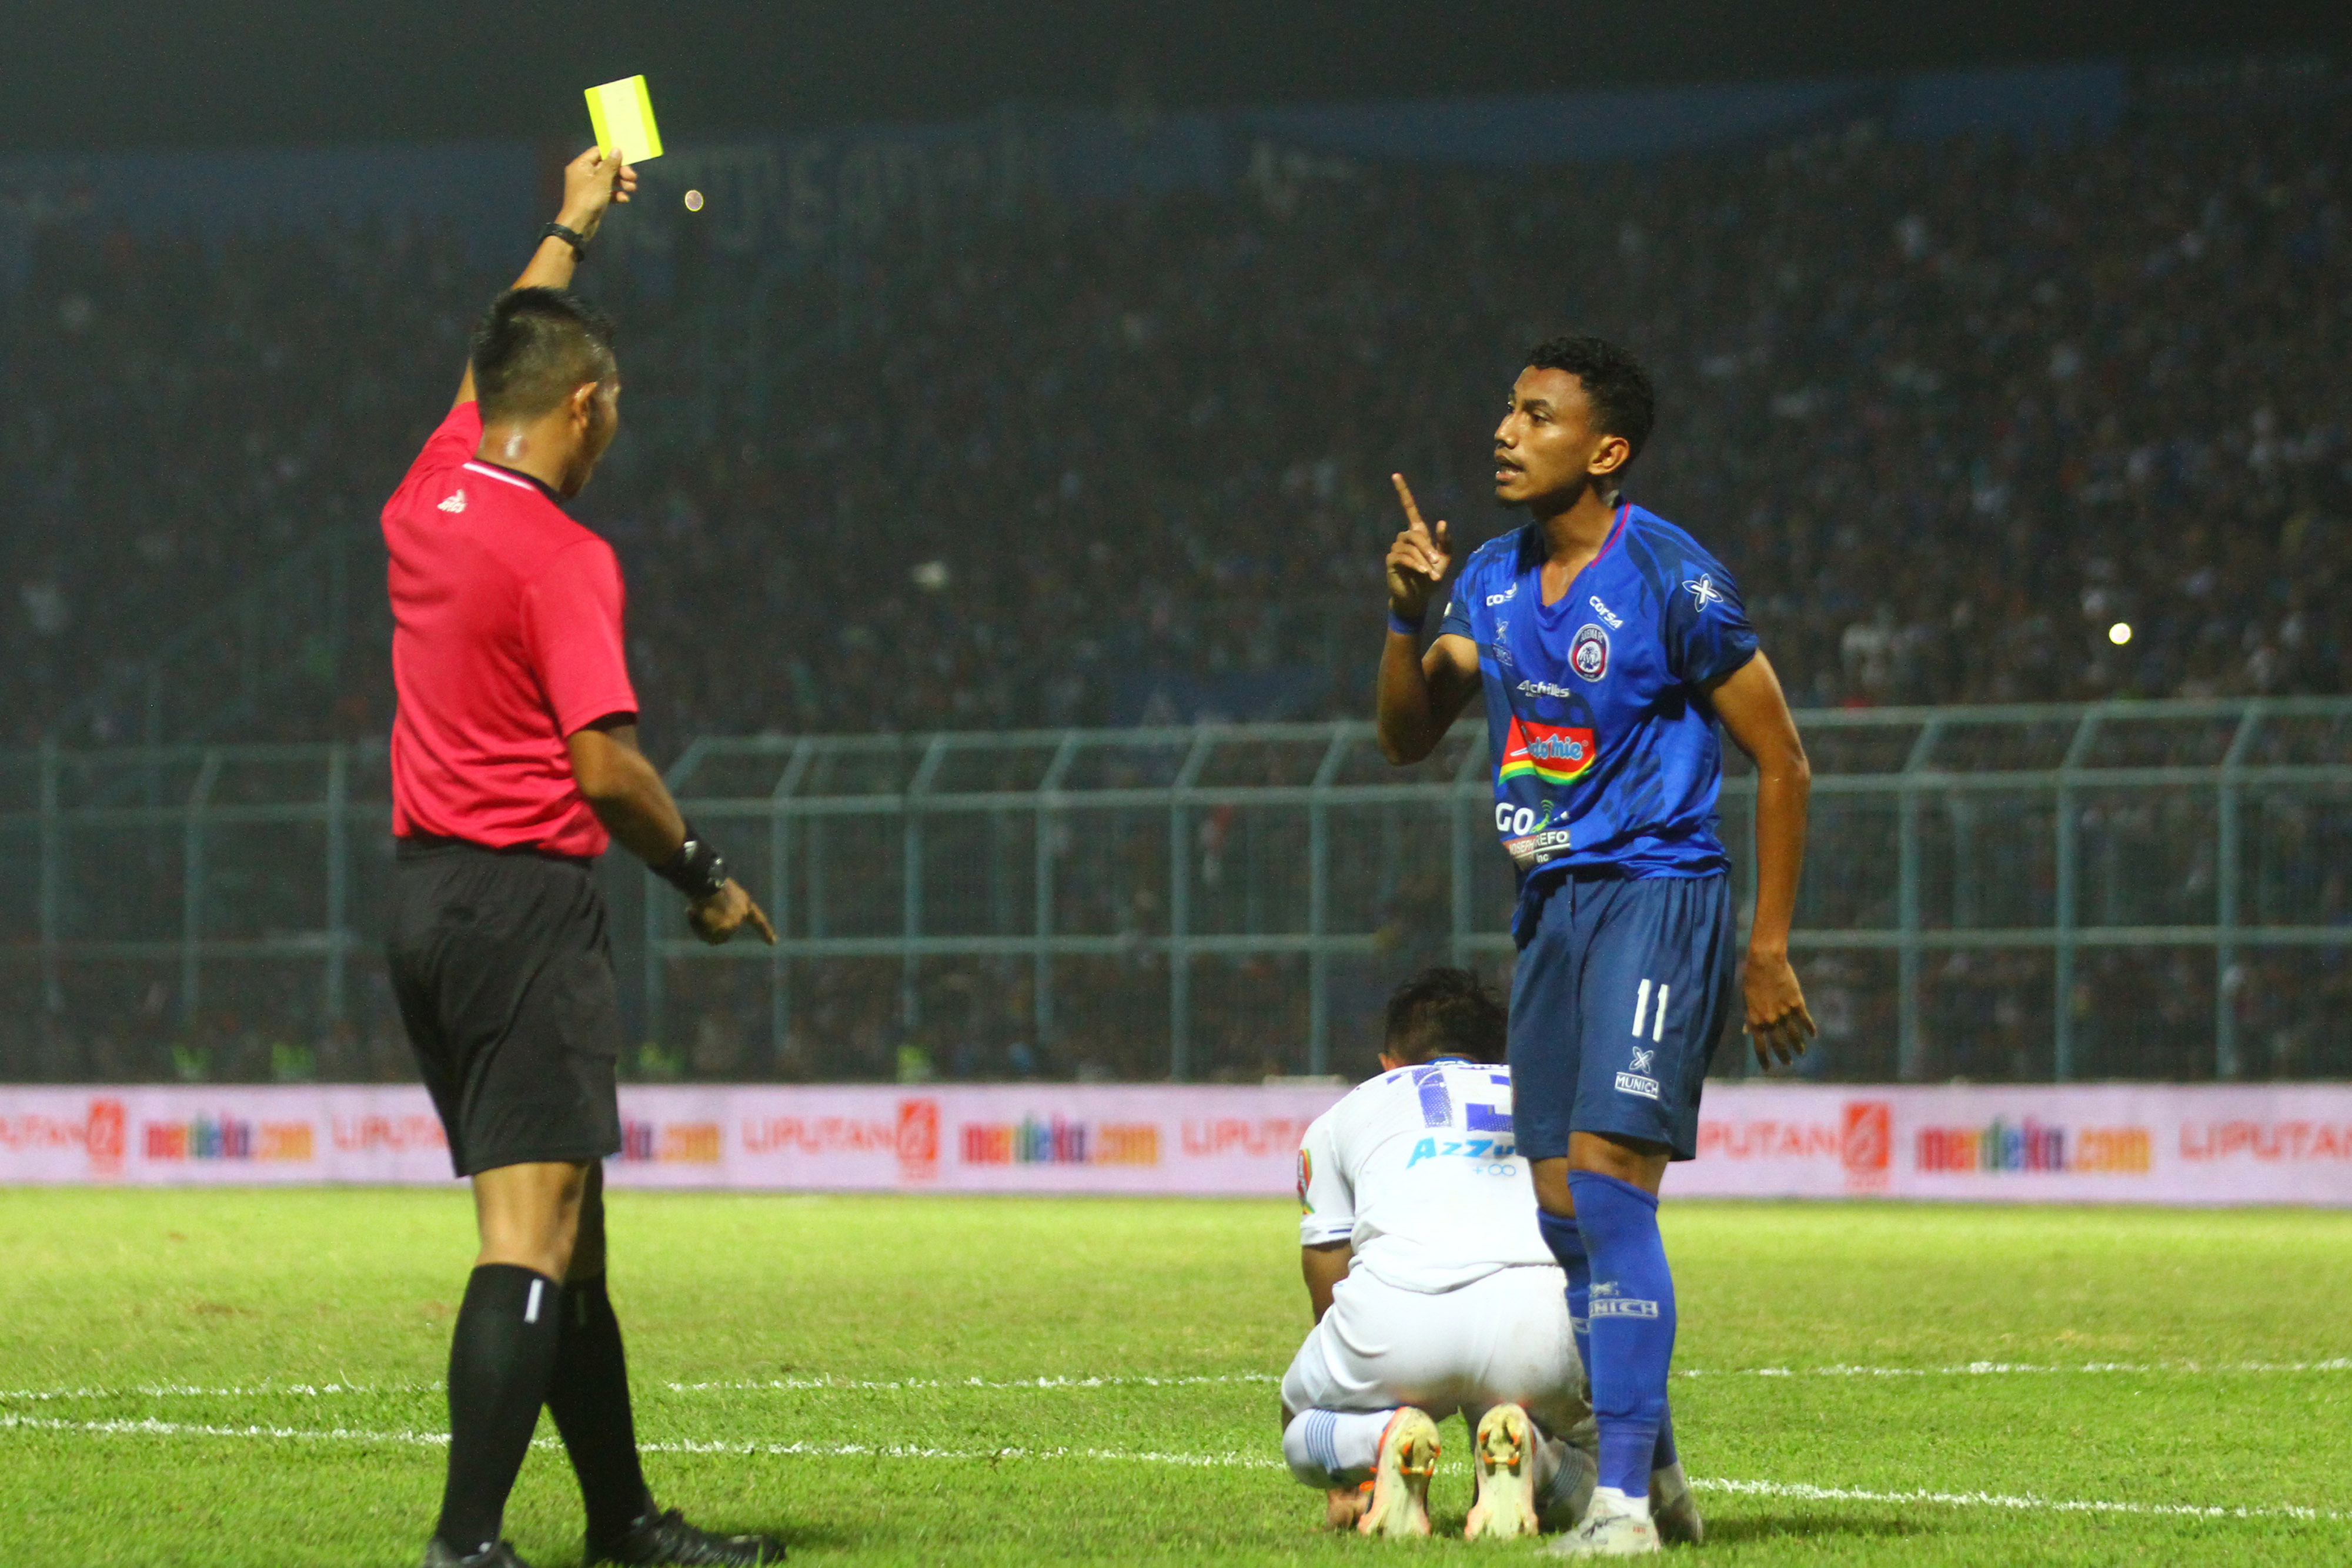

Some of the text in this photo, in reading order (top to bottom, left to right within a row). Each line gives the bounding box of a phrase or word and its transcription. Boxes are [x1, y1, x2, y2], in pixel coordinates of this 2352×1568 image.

[1516, 680, 1570, 697] Achilles
[1632, 978, 1669, 1043] 11
[1617, 1076, 1659, 1095] MUNICH
